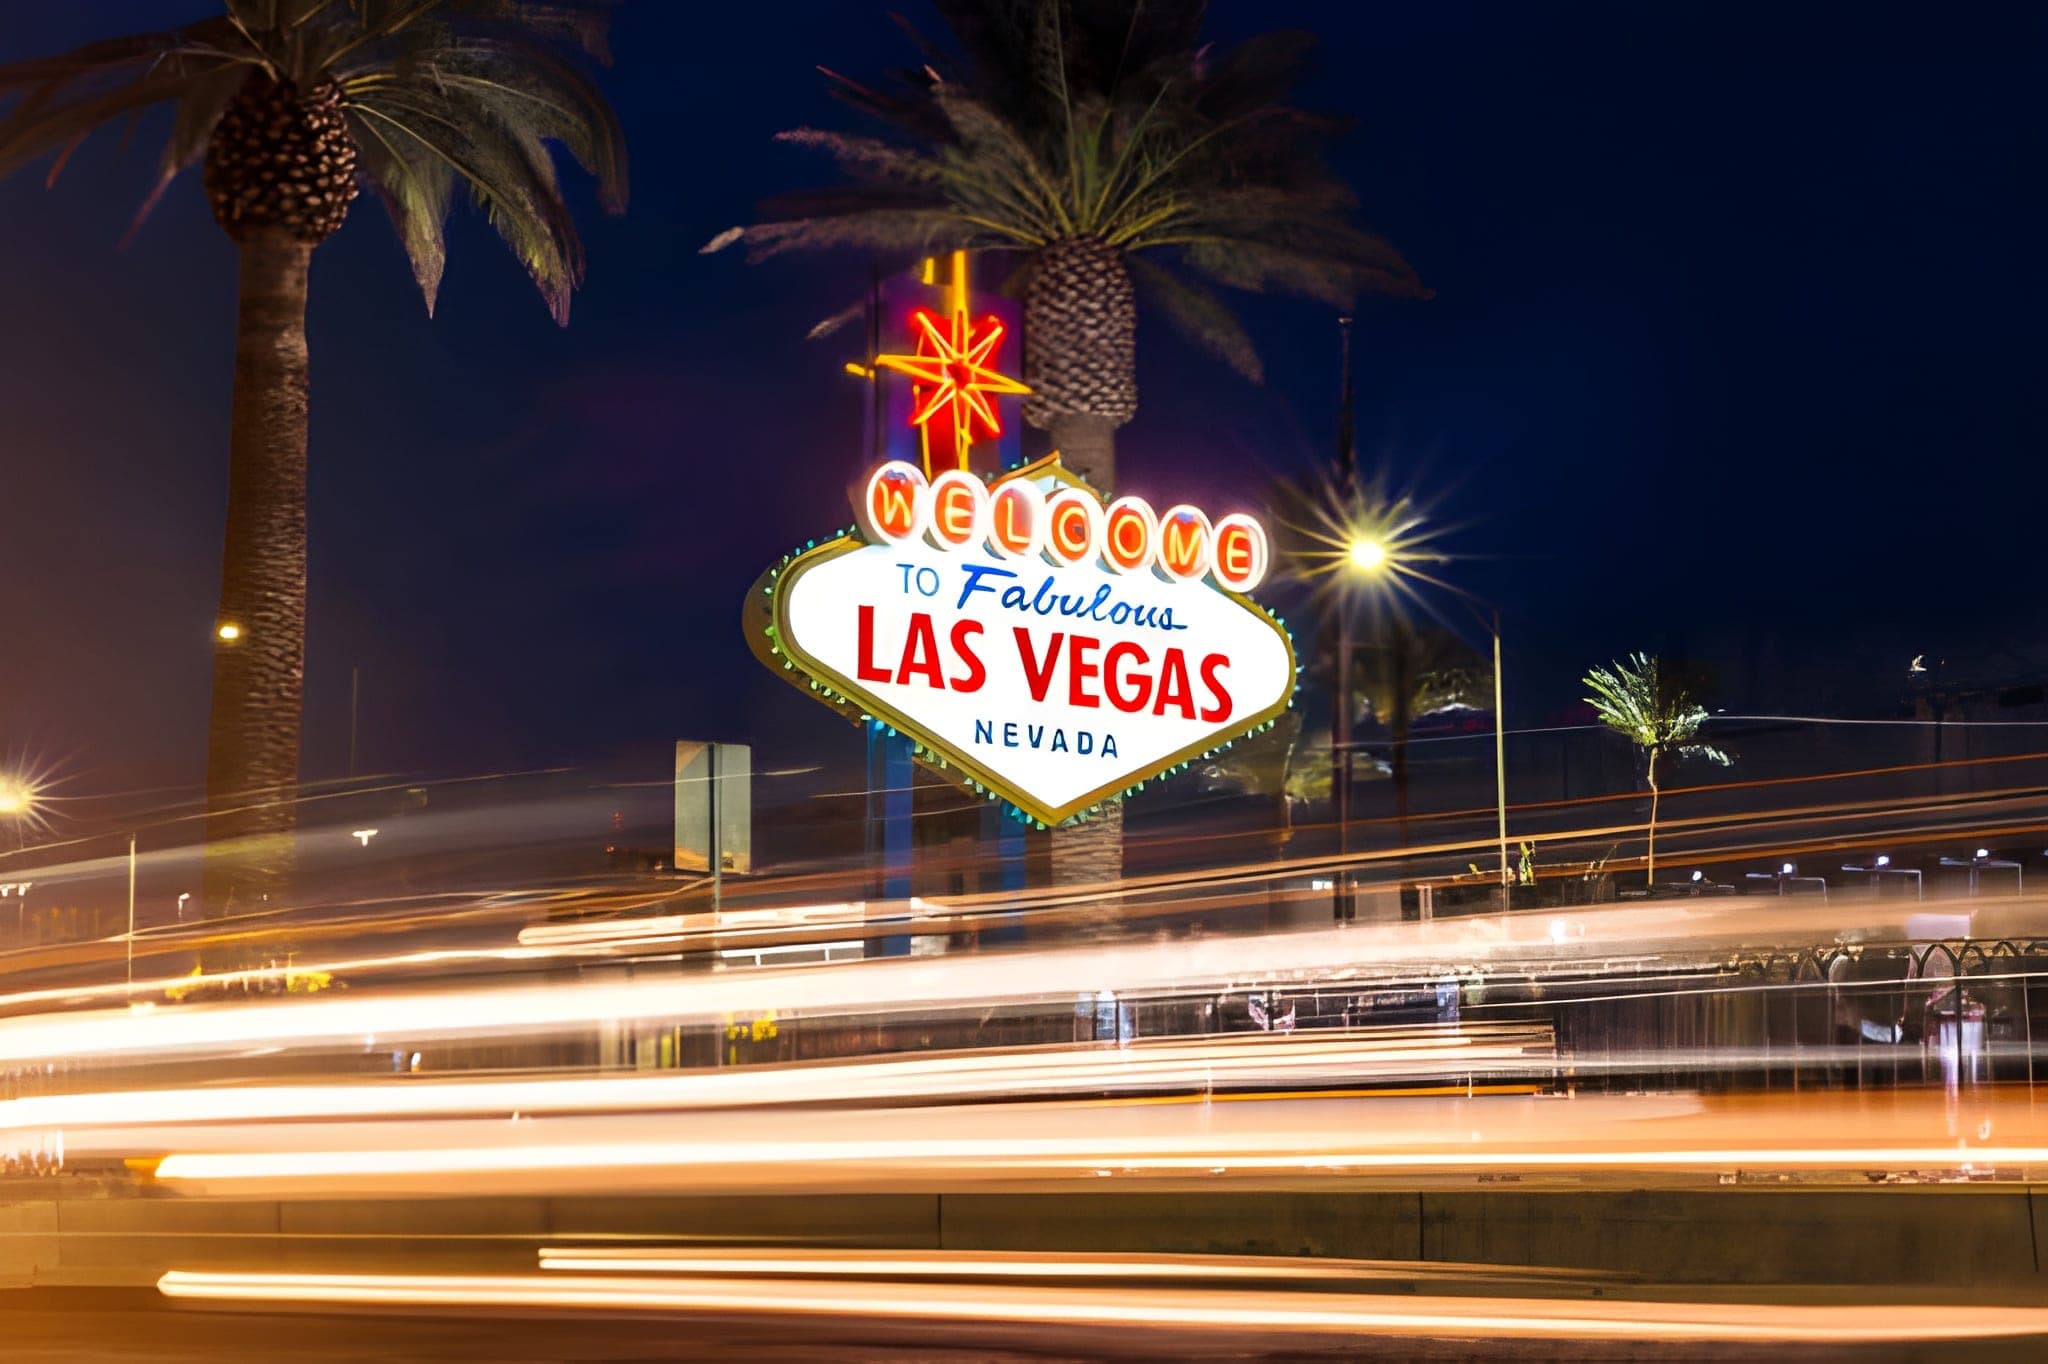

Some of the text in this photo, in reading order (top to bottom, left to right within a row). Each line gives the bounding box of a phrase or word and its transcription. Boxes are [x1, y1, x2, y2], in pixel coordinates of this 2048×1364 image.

[874, 475, 1256, 577] WELCOME
[896, 563, 1189, 630] TO Fabulous
[857, 605, 1233, 724] LAS VEGAS
[975, 720, 1118, 758] NEVADA
